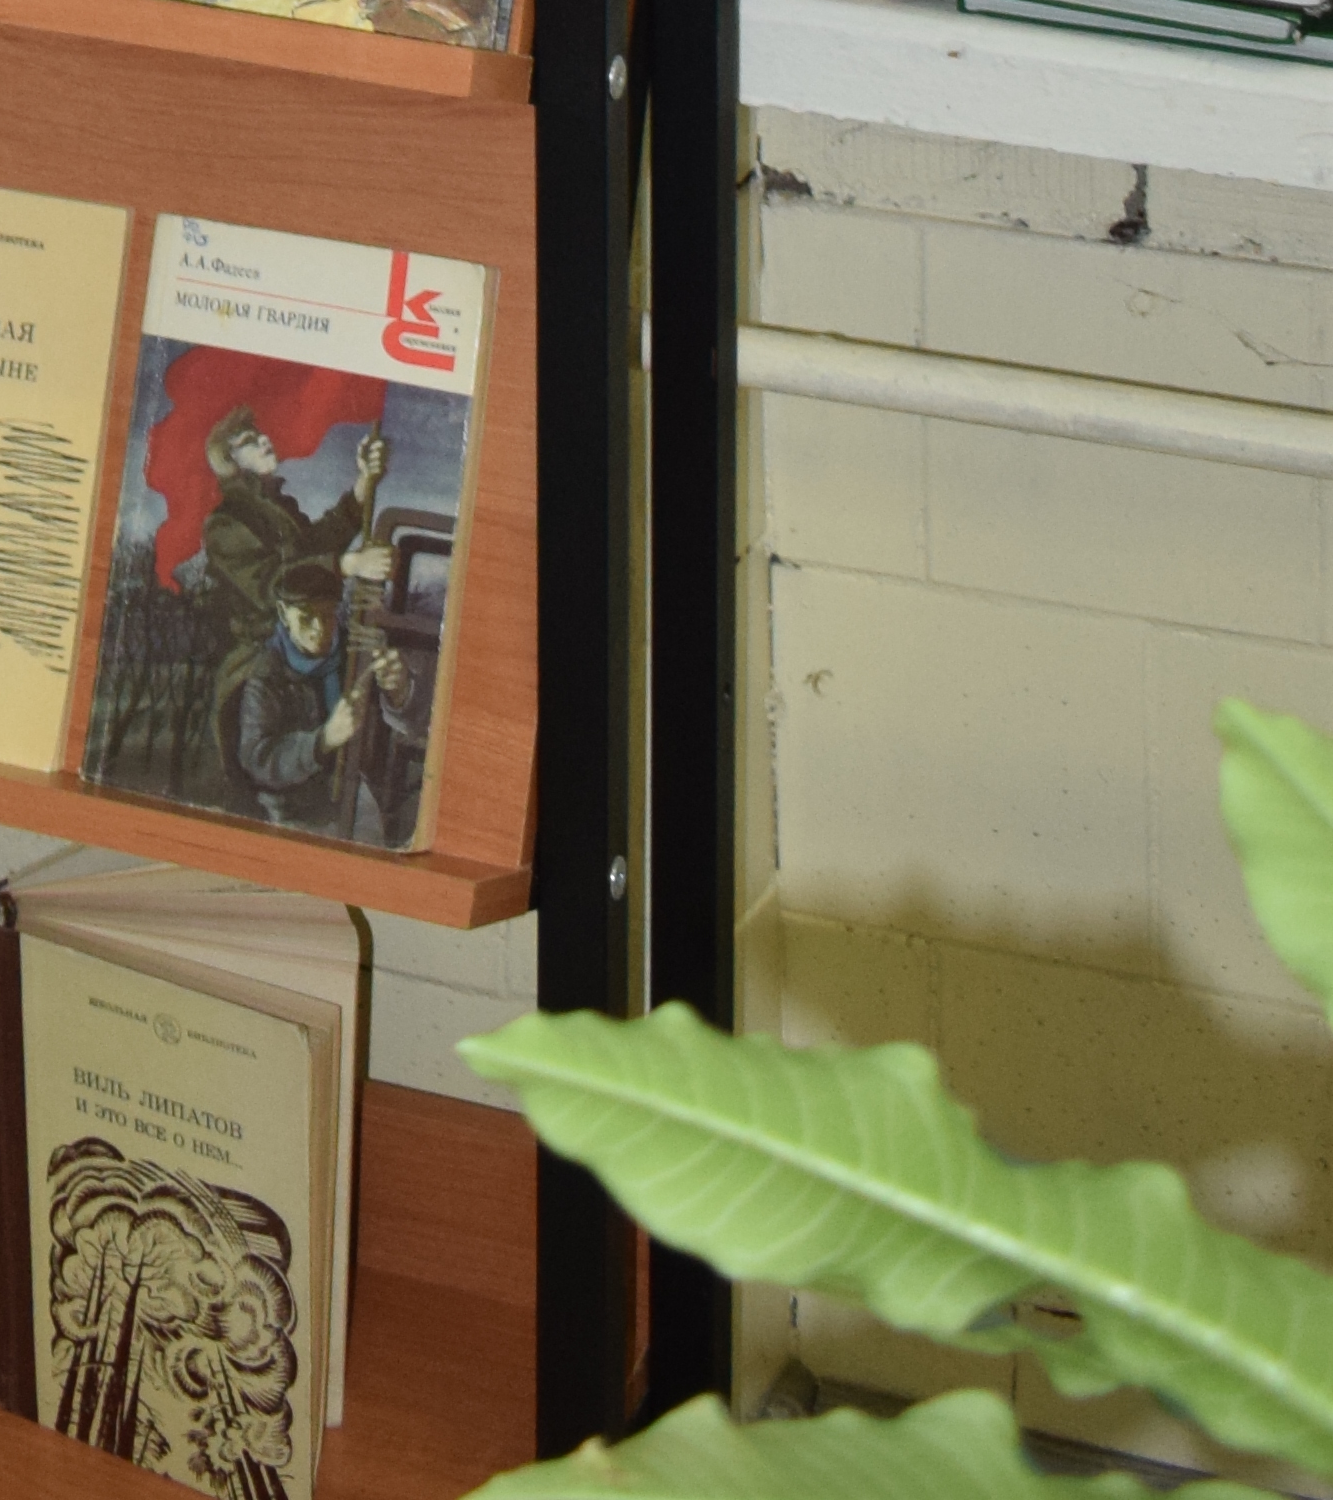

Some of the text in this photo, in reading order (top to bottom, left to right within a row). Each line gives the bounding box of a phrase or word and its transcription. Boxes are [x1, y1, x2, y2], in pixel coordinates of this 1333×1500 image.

[175, 290, 331, 334] МОЛОДАЯ ГВАРДИЯ
[73, 1066, 244, 1140] ВИЛЬ ЛИПАТОВ
[75, 1096, 89, 1115] И
[93, 1103, 128, 1128] ЭТО
[133, 1117, 168, 1143] ВСЕ
[172, 1131, 186, 1149] О
